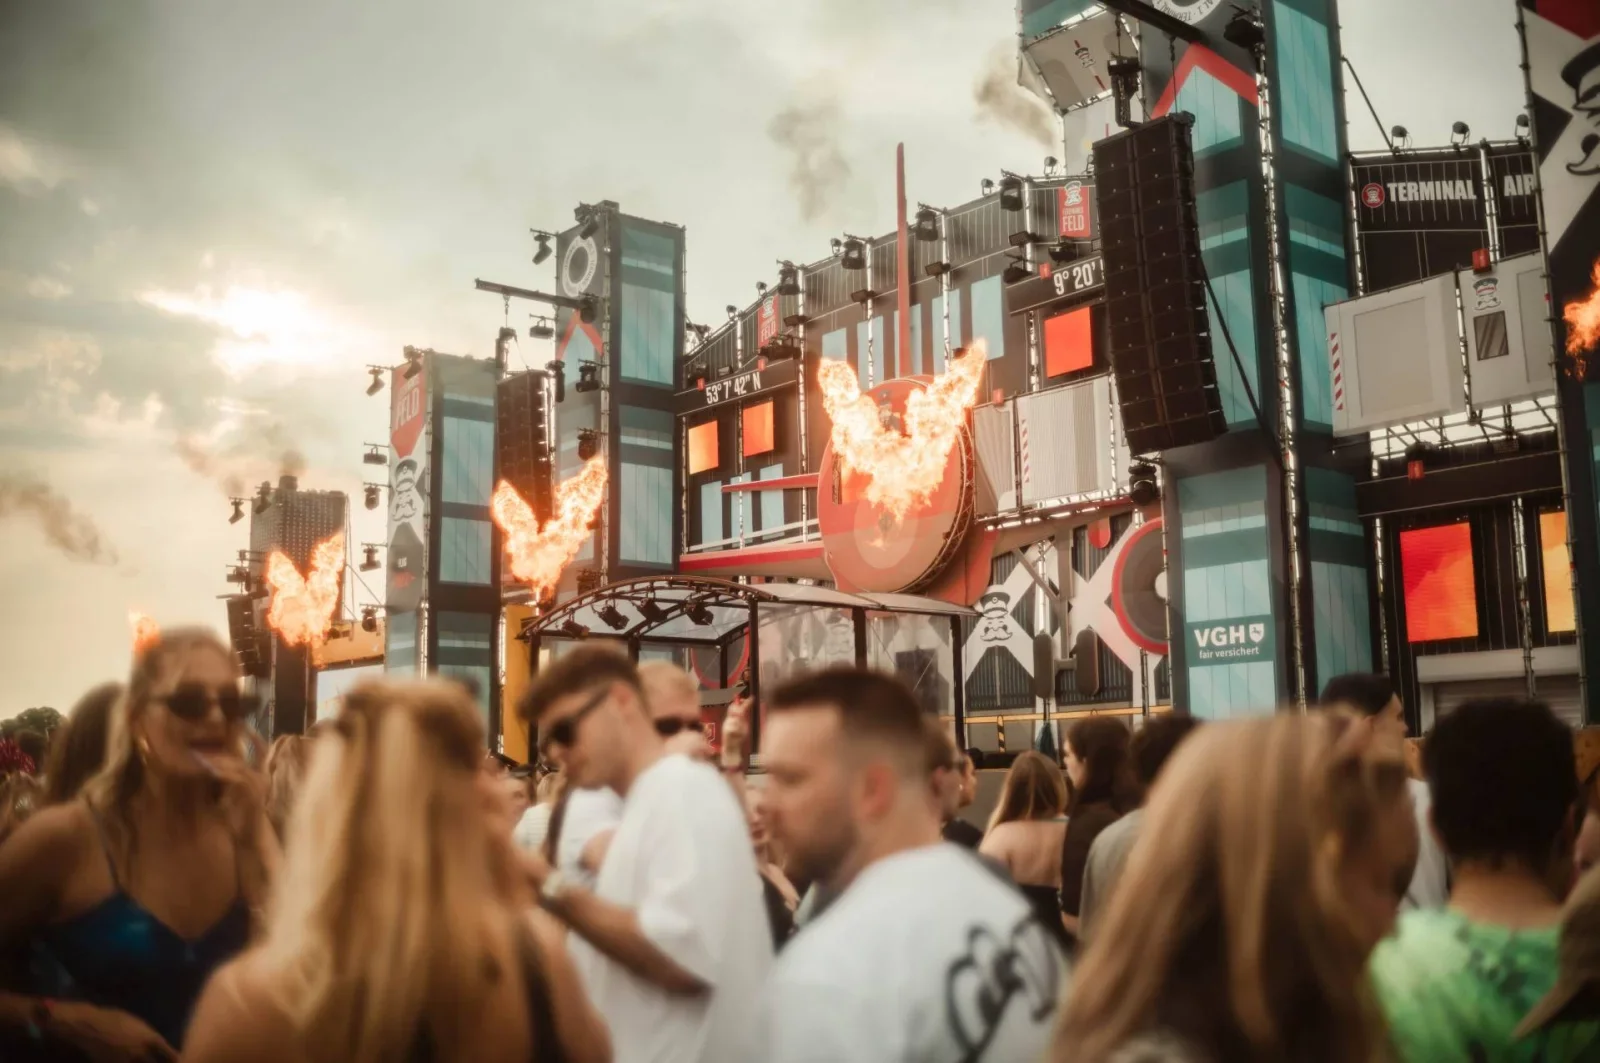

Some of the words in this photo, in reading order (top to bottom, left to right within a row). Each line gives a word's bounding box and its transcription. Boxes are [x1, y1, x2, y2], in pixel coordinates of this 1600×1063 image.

[1387, 179, 1477, 202] TERMINAL
[1062, 214, 1085, 232] FELD
[1053, 270, 1069, 295] 9°
[1072, 261, 1096, 290] 20'
[761, 319, 776, 342] FELD
[705, 383, 721, 404] 53°
[723, 379, 732, 399] 7'
[752, 371, 761, 391] N
[1194, 625, 1246, 647] VGH
[1199, 650, 1213, 659] fair
[1215, 646, 1260, 657] versichert
